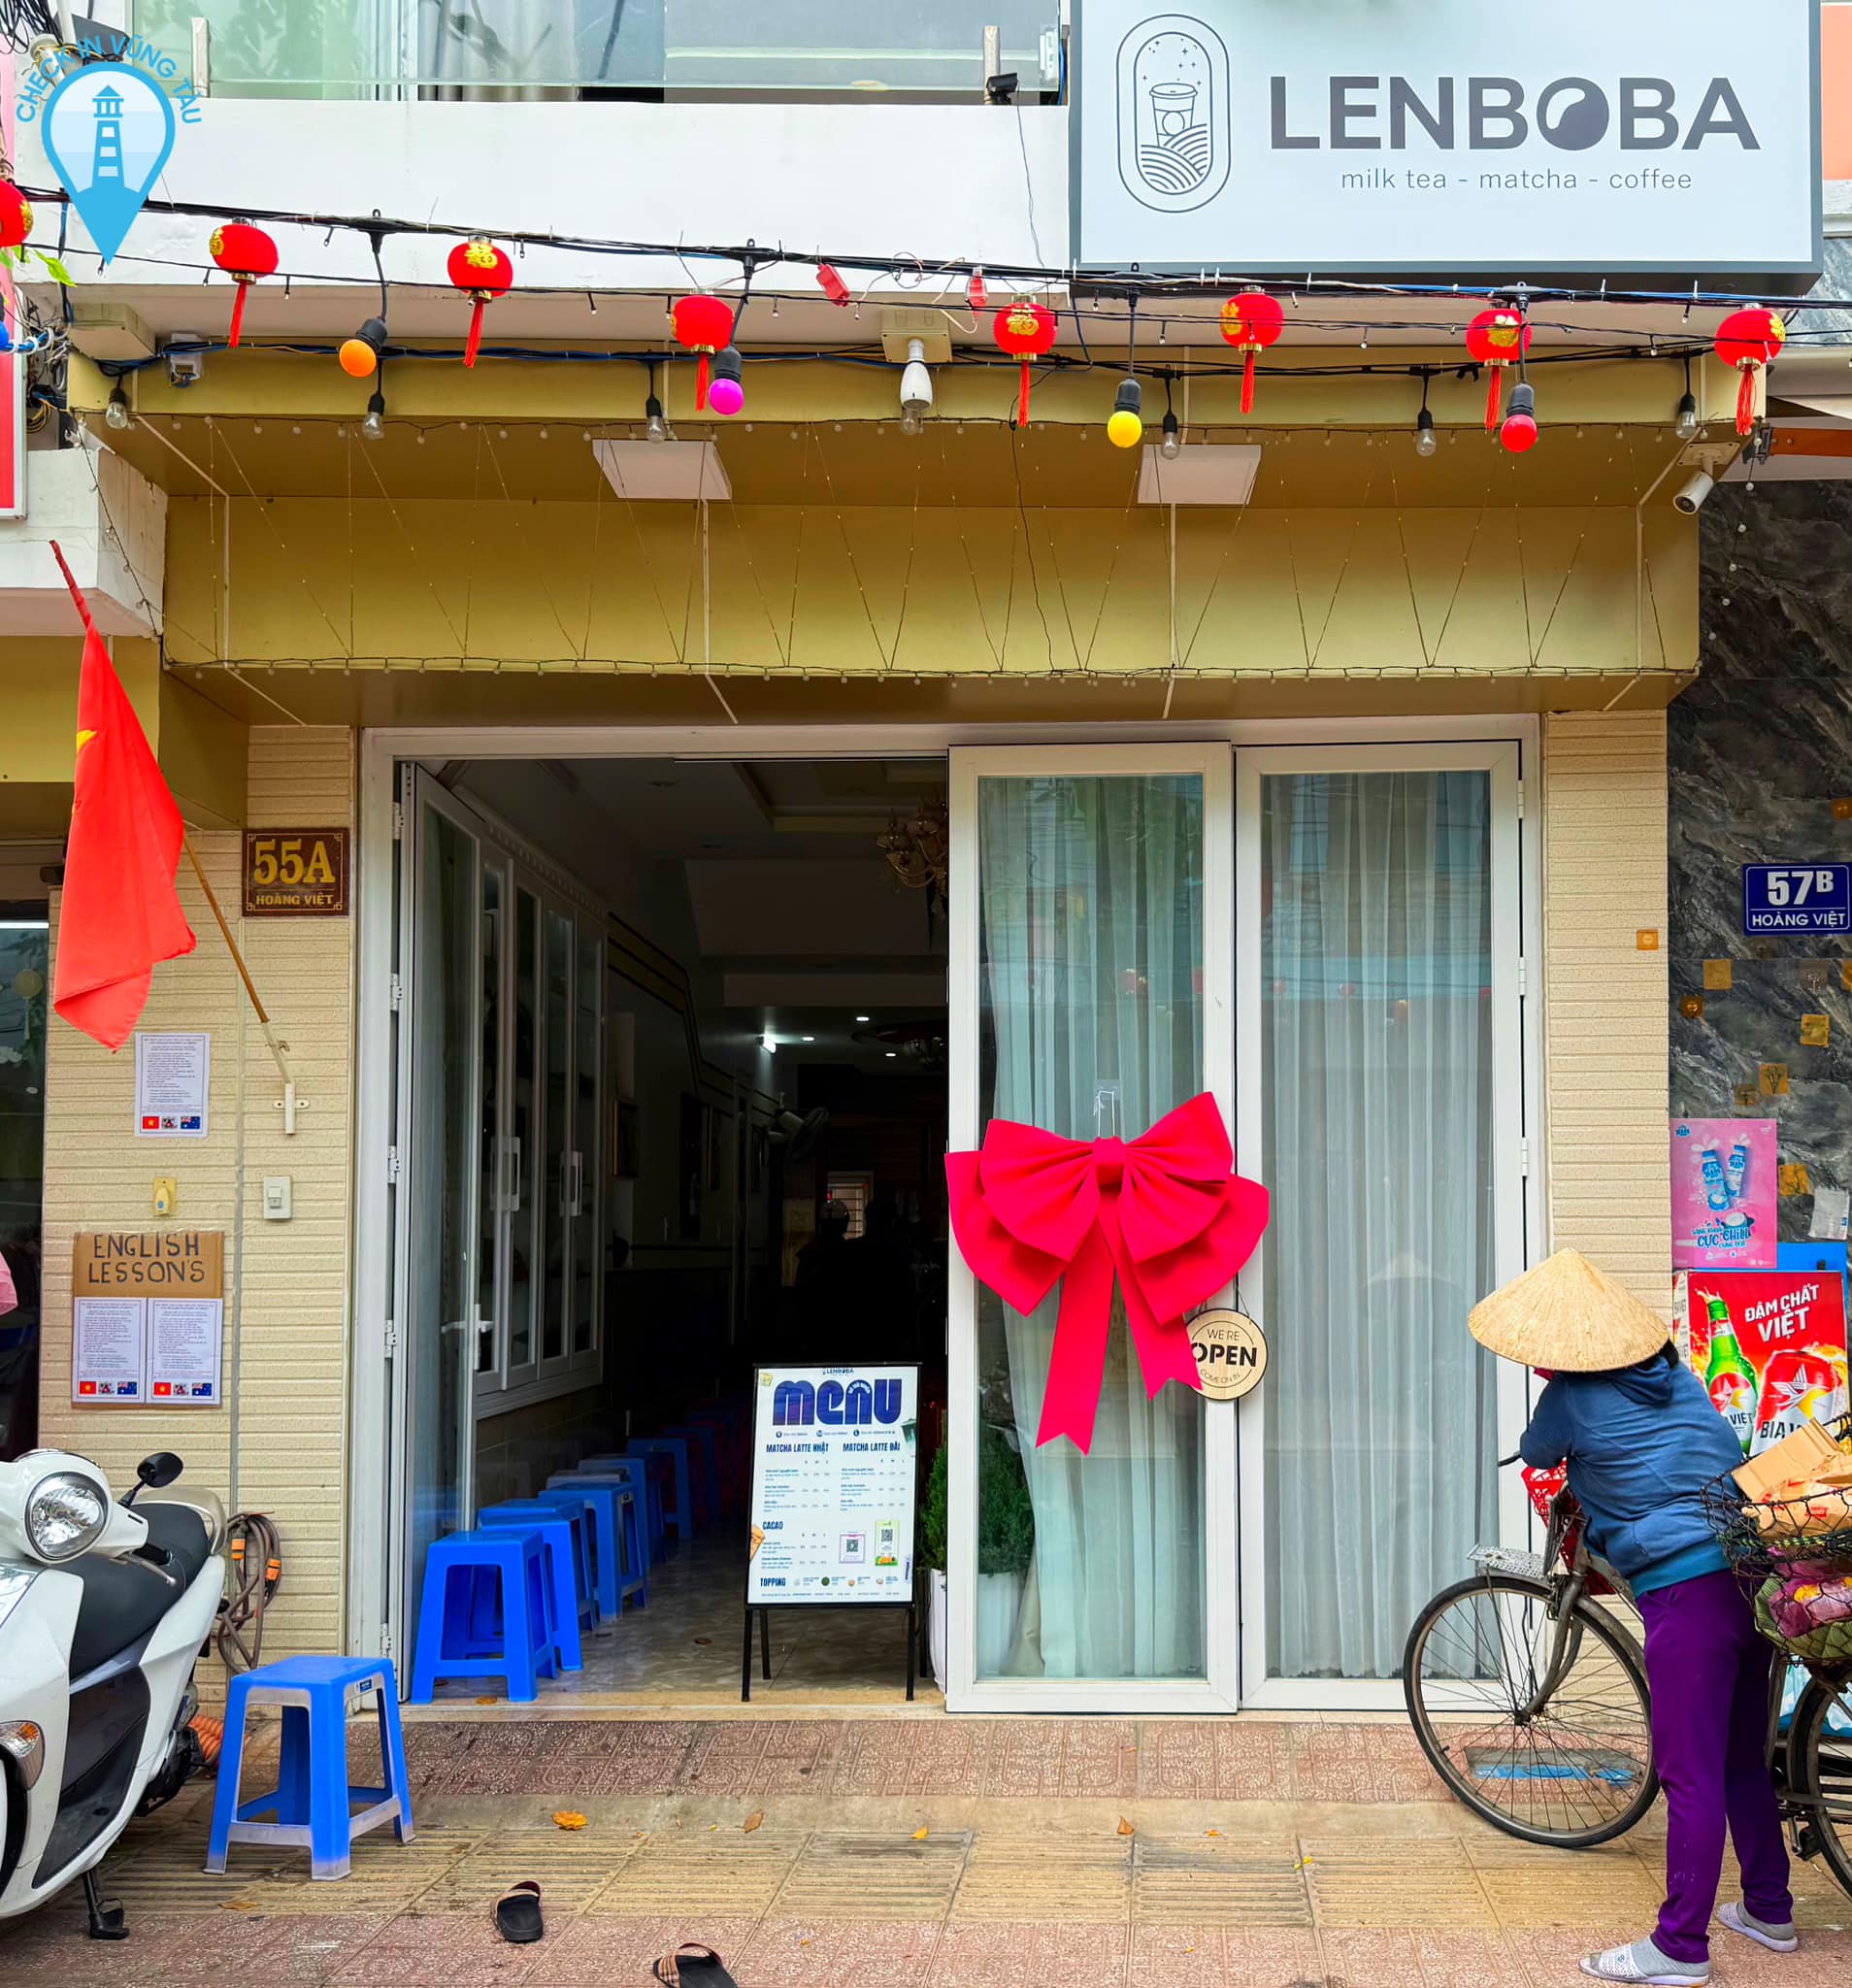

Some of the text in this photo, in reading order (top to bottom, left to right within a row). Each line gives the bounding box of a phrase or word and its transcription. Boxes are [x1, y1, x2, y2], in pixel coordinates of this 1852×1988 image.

[1270, 76, 1762, 151] LENBOBA
[1341, 167, 1396, 189] milk
[1406, 169, 1446, 189] tea
[1479, 167, 1577, 189] matcha
[1609, 167, 1692, 189] coffee
[253, 838, 336, 885] 55A
[255, 892, 334, 907] HOÀNG VIỆT
[1752, 910, 1846, 928] HOÀNG VIỆT
[93, 1232, 200, 1259] ENGLISH
[1745, 1283, 1820, 1322] ĐẬM CHẤT
[1758, 1307, 1810, 1342] VIỆT
[1191, 1342, 1258, 1368] OPEN
[1760, 1420, 1786, 1440] BIA
[766, 1443, 792, 1453] MATCHA
[793, 1442, 811, 1453] LATTE
[843, 1442, 869, 1452] MATCHA
[870, 1441, 888, 1452] LATTE
[762, 1521, 783, 1531] CACAO
[760, 1577, 786, 1588] TOPPING
